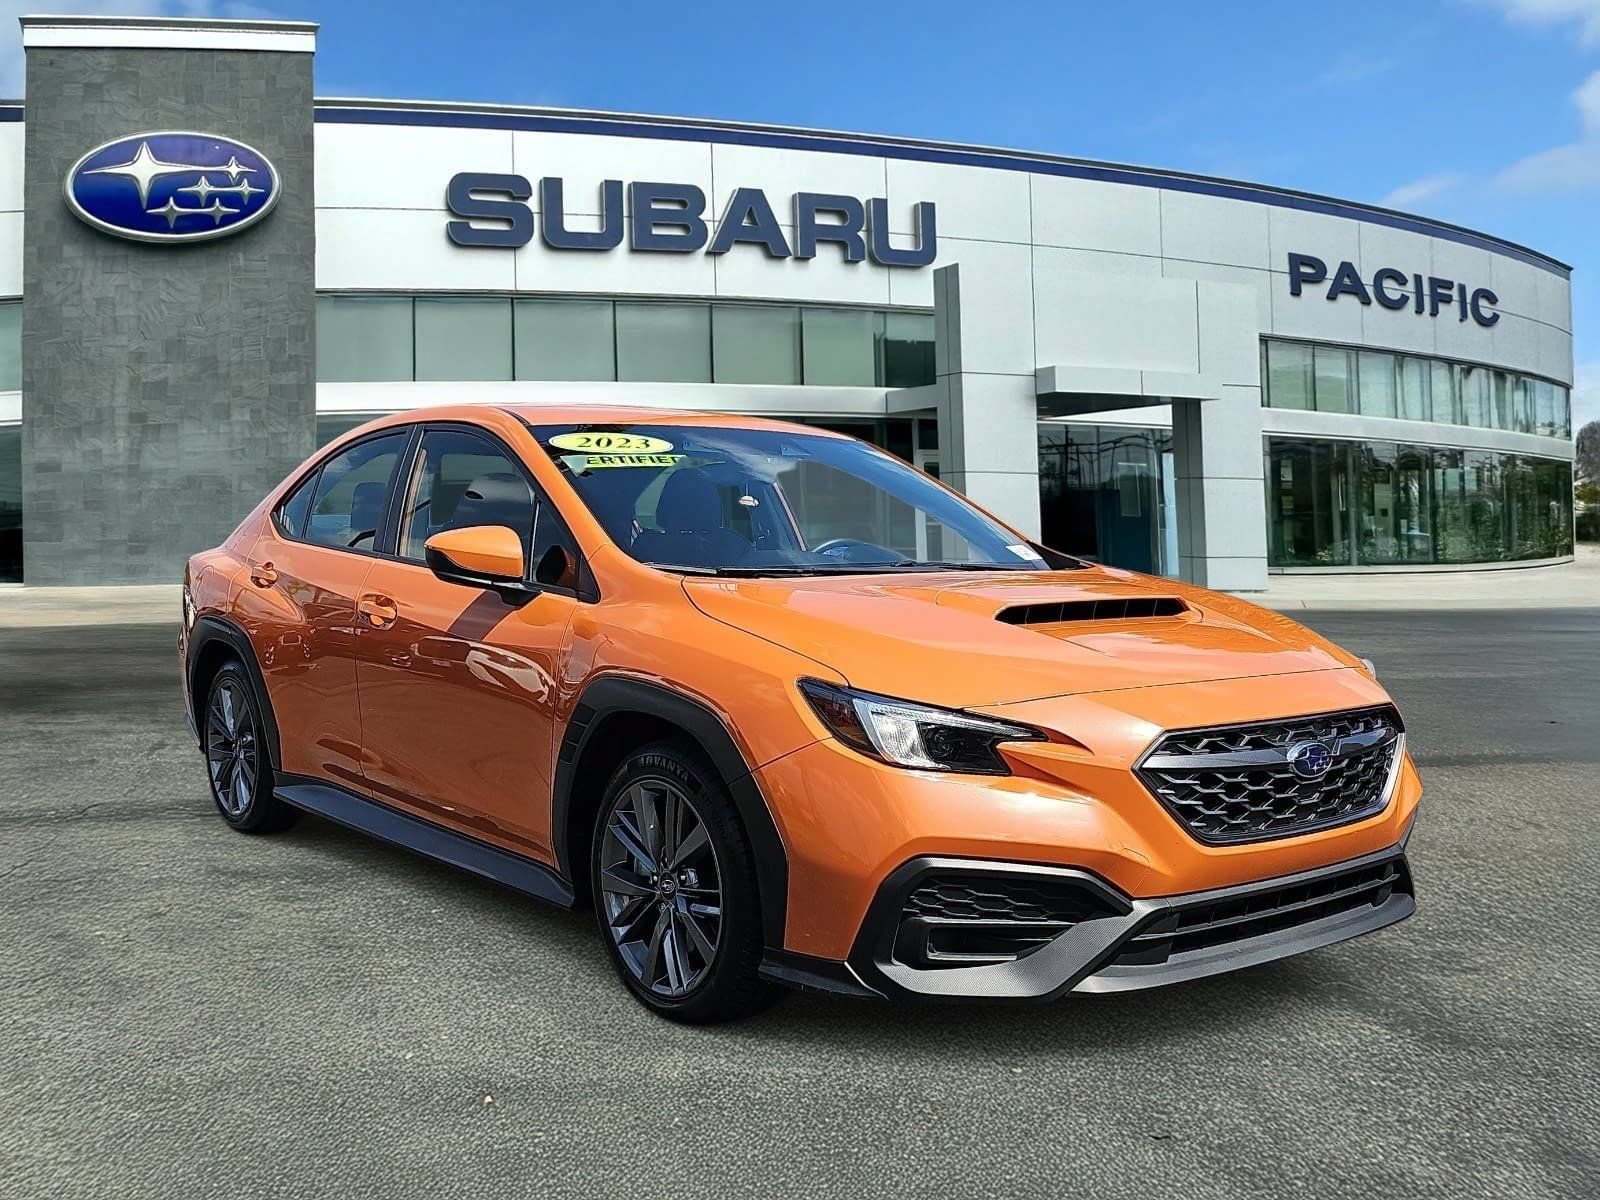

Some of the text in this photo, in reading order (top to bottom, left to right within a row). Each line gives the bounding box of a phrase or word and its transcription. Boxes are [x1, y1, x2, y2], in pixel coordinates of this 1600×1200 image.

[447, 172, 937, 267] SUBARU
[1288, 252, 1500, 327] PACIFIC
[577, 437, 650, 449] 2023
[586, 455, 677, 466] ERTIFIE
